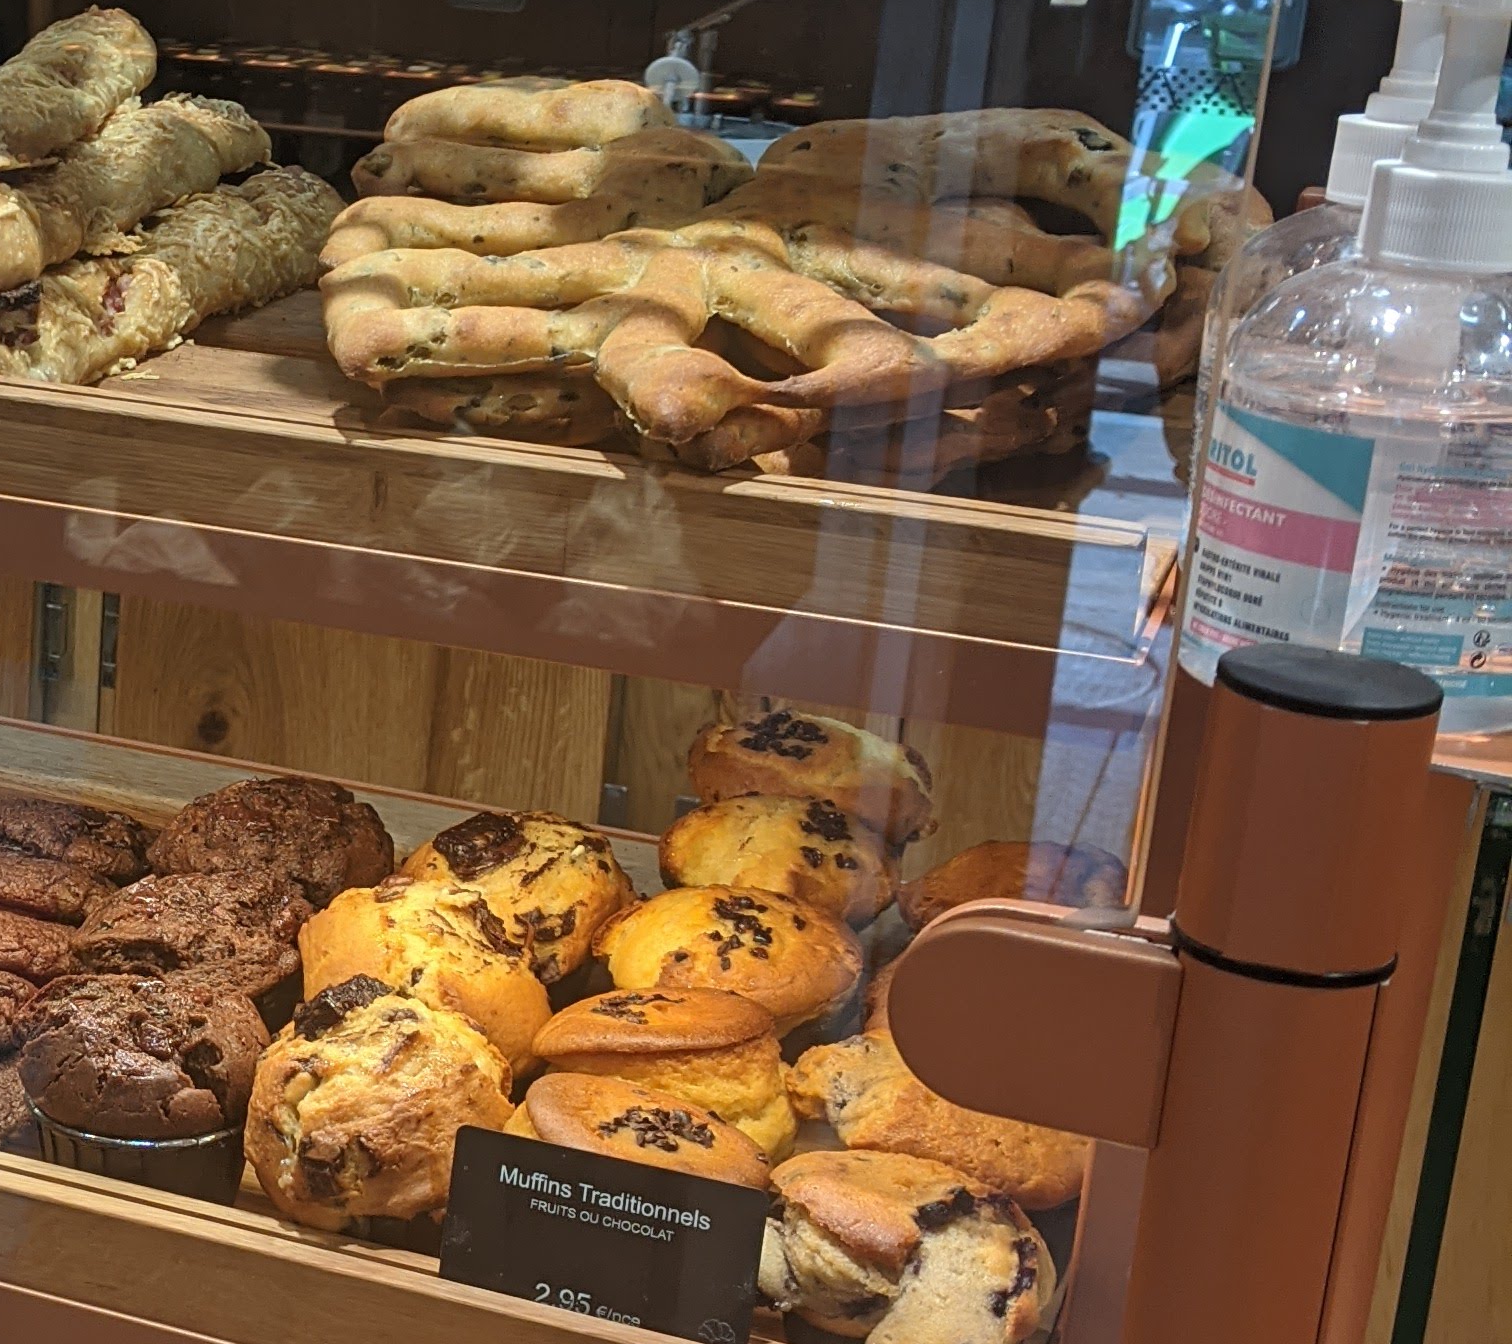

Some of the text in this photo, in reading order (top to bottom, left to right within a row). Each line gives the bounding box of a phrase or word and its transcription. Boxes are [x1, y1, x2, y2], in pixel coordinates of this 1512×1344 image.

[499, 1164, 711, 1231] Muffins Traditionnels
[530, 1198, 674, 1243] FRUITS OU CHOCOLAT
